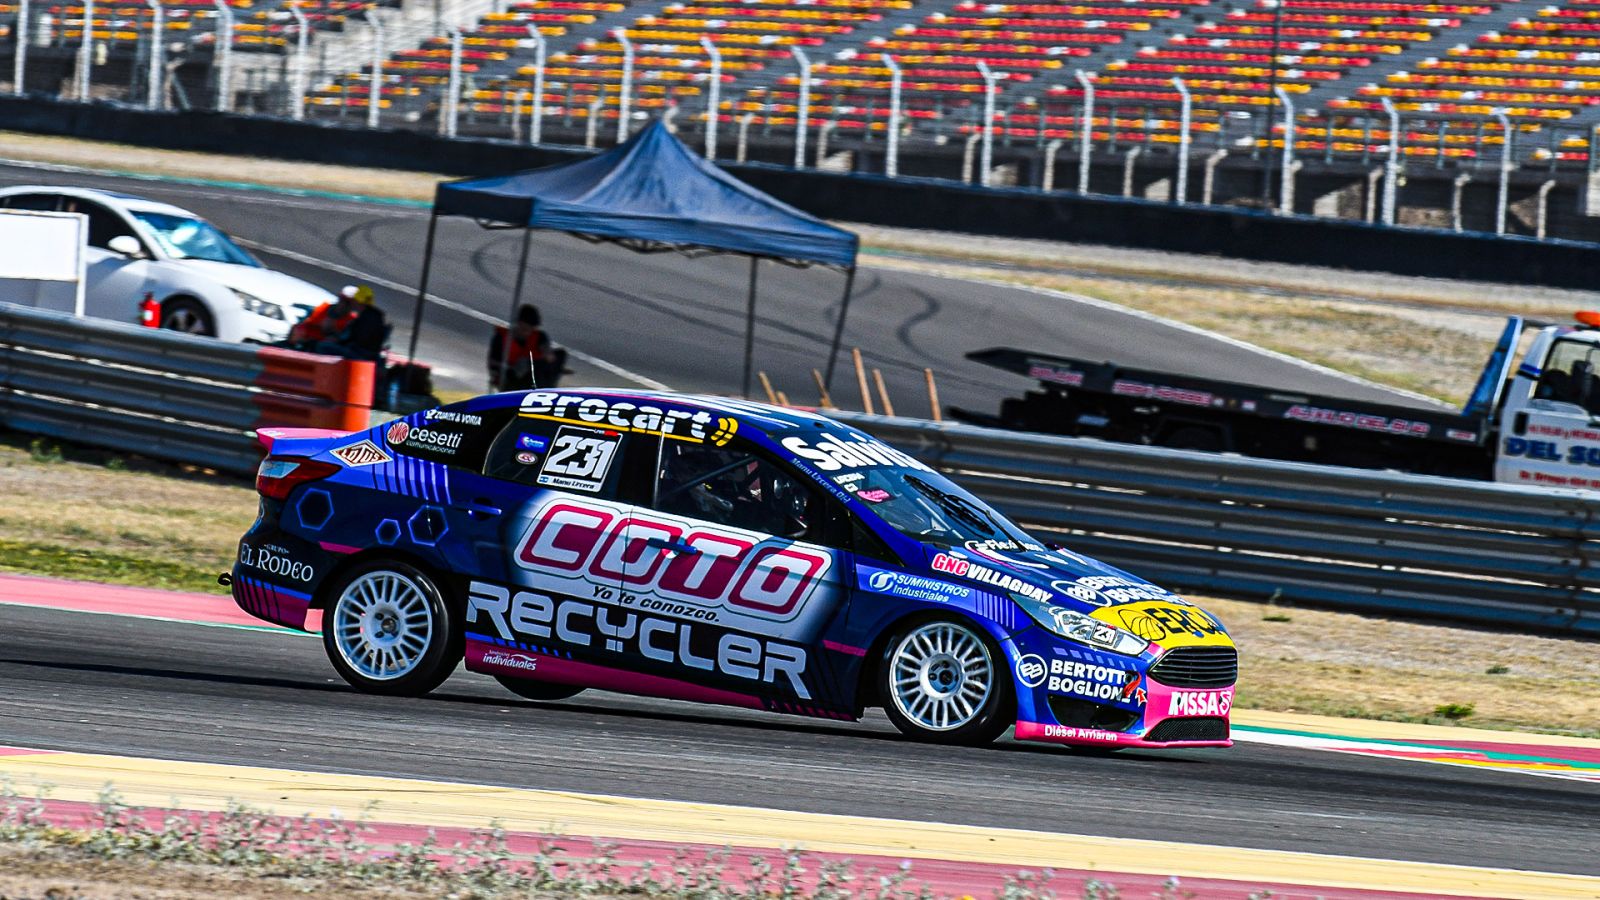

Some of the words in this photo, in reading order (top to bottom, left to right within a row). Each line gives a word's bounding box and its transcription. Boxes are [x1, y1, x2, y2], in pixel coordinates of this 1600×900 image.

[519, 392, 712, 439] Brocart
[409, 427, 463, 448] cesetti
[1503, 436, 1563, 462] DEL
[544, 435, 617, 479] 231
[553, 478, 571, 487] Manu
[571, 481, 596, 490] Urcera
[240, 543, 255, 567] EL
[256, 548, 314, 582] RODEO
[518, 502, 826, 616] COTO
[896, 574, 970, 598] SUMINISTROS
[932, 553, 969, 576] GNC
[966, 564, 1053, 603] VILLAGUAY
[593, 586, 613, 600] Yo
[618, 591, 636, 605] te
[640, 598, 720, 622] conozco.
[893, 585, 950, 602] Industriales
[483, 653, 537, 671] individuales
[1048, 676, 1131, 704] BOGLION
